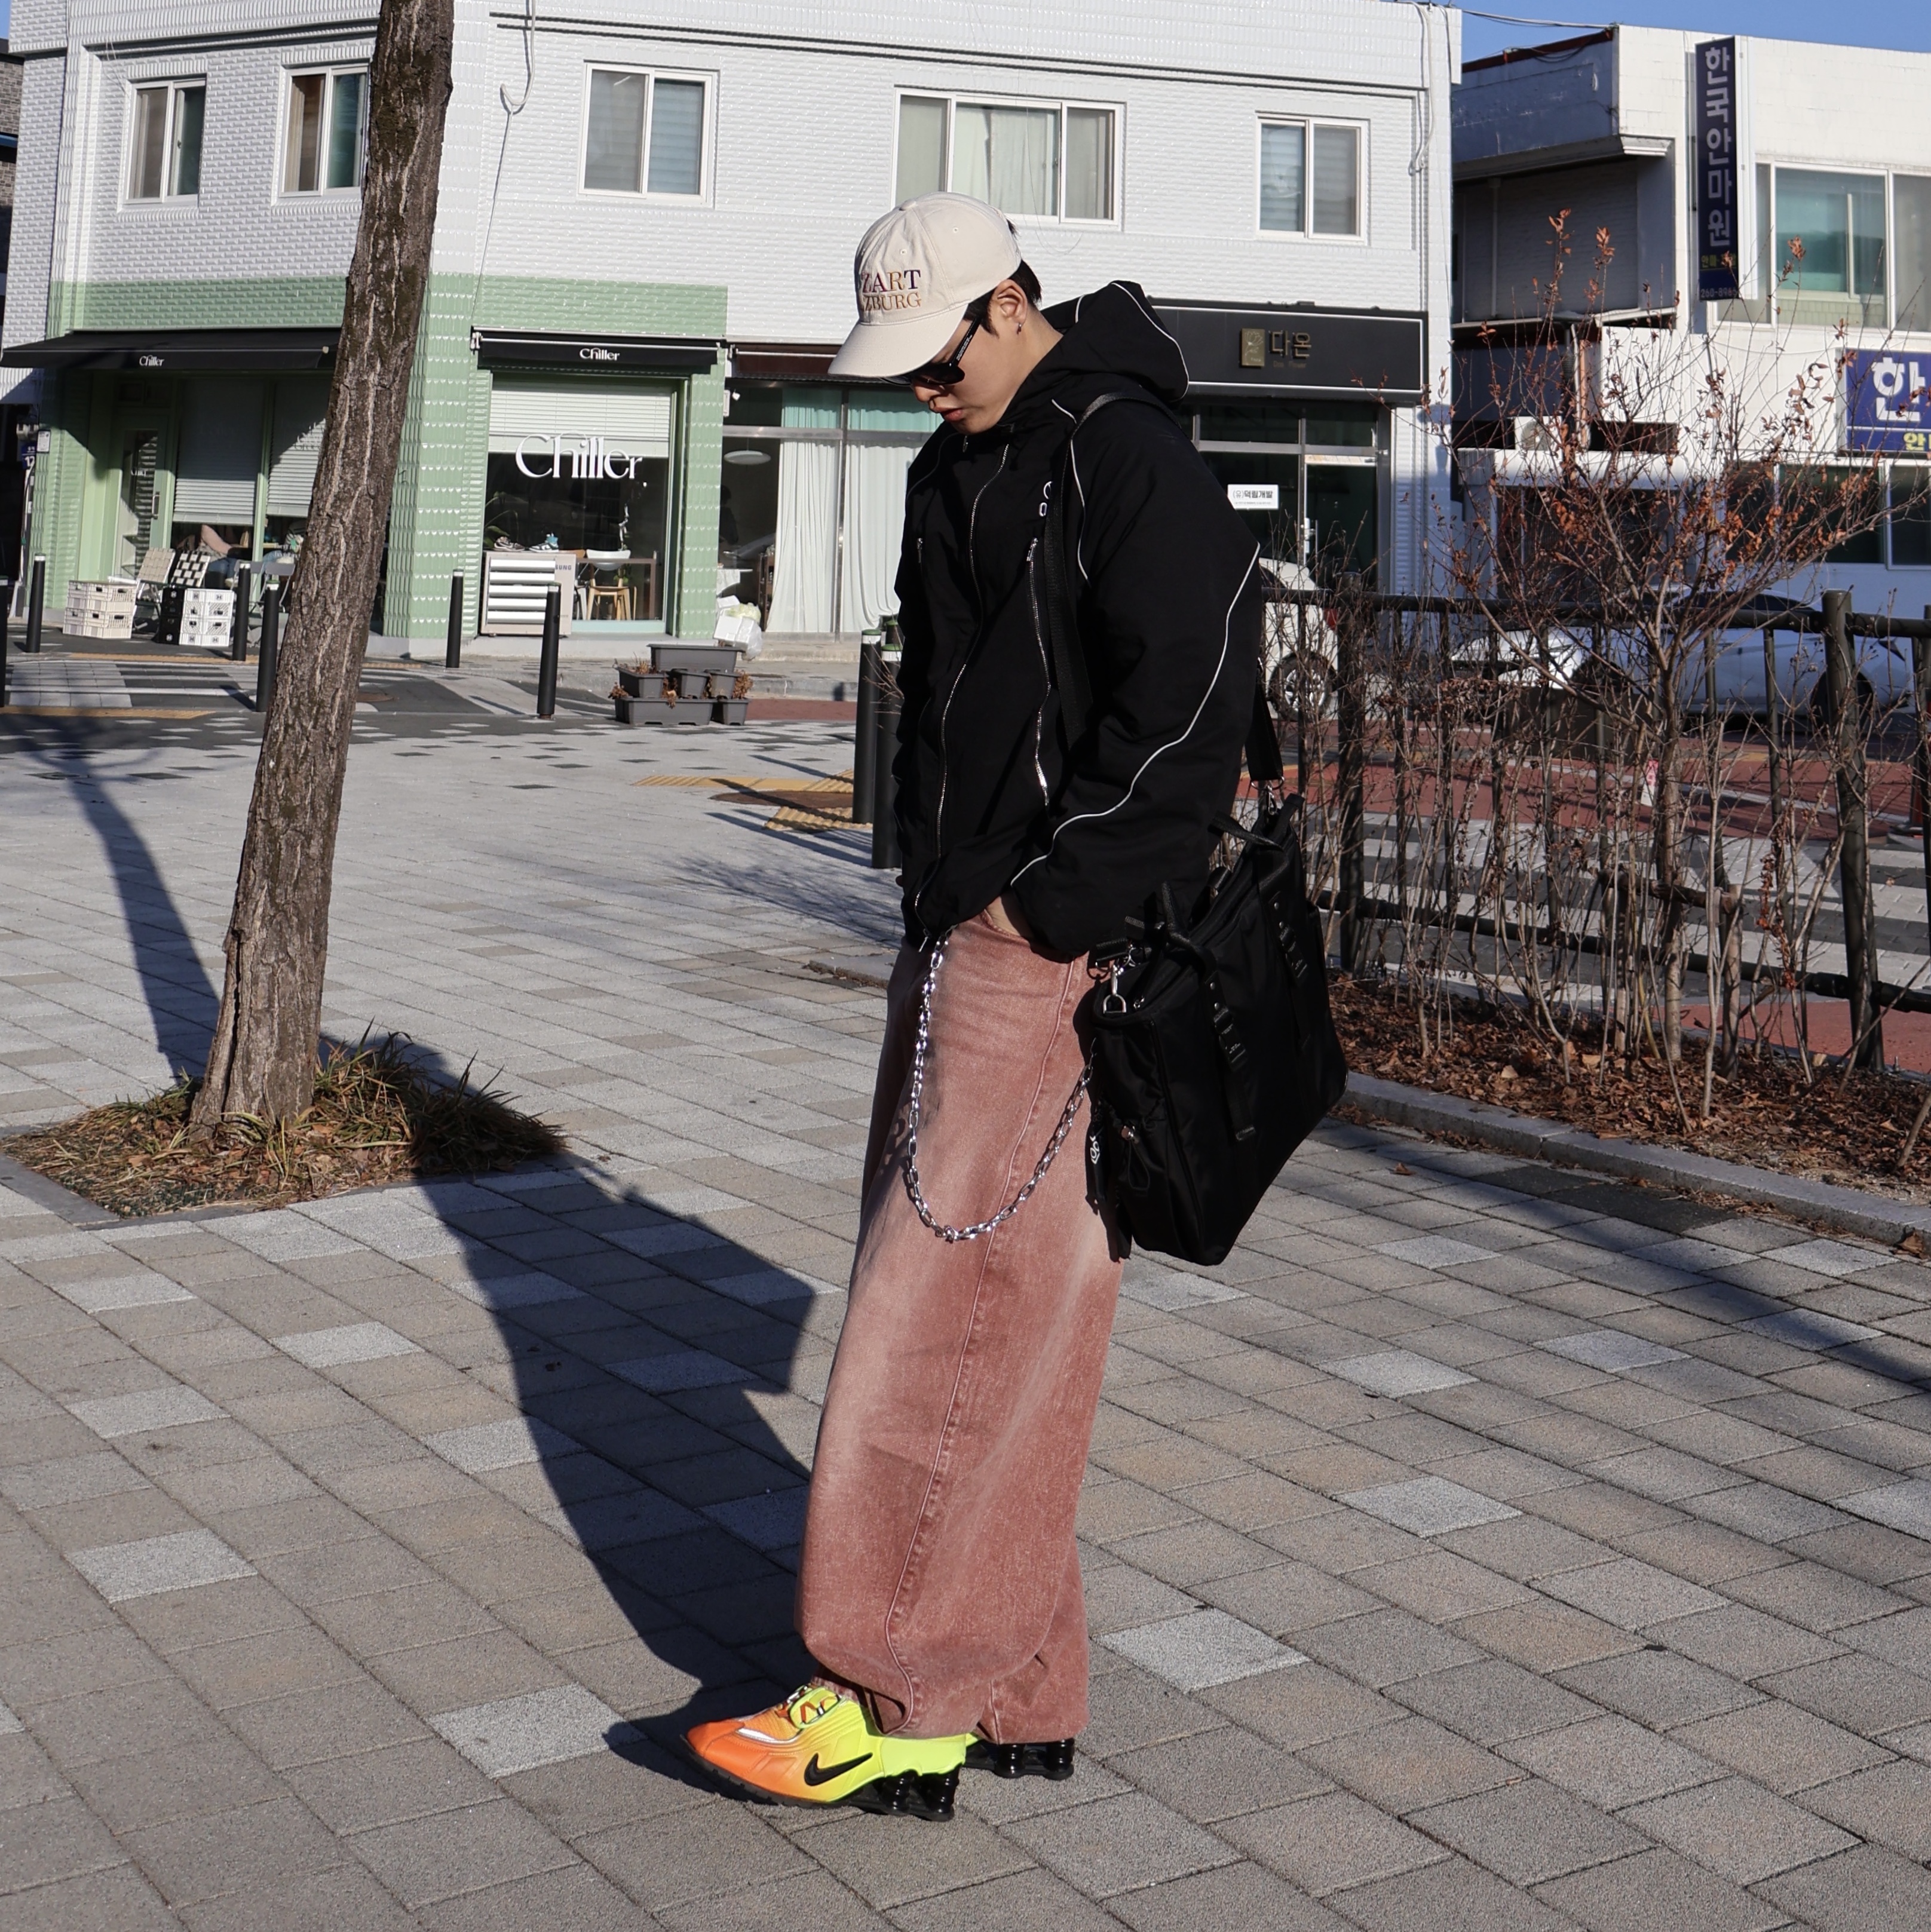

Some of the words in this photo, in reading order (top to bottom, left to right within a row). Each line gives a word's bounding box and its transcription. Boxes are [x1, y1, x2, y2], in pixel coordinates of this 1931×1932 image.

[1705, 47, 1731, 247] 한국안마원
[861, 269, 921, 293] ZART
[863, 292, 921, 311] ZBURG
[1272, 330, 1311, 357] 다온
[139, 354, 164, 366] Chiller
[580, 348, 620, 361] Chiller
[1904, 432, 1931, 451] 안
[516, 430, 643, 479] Chiller
